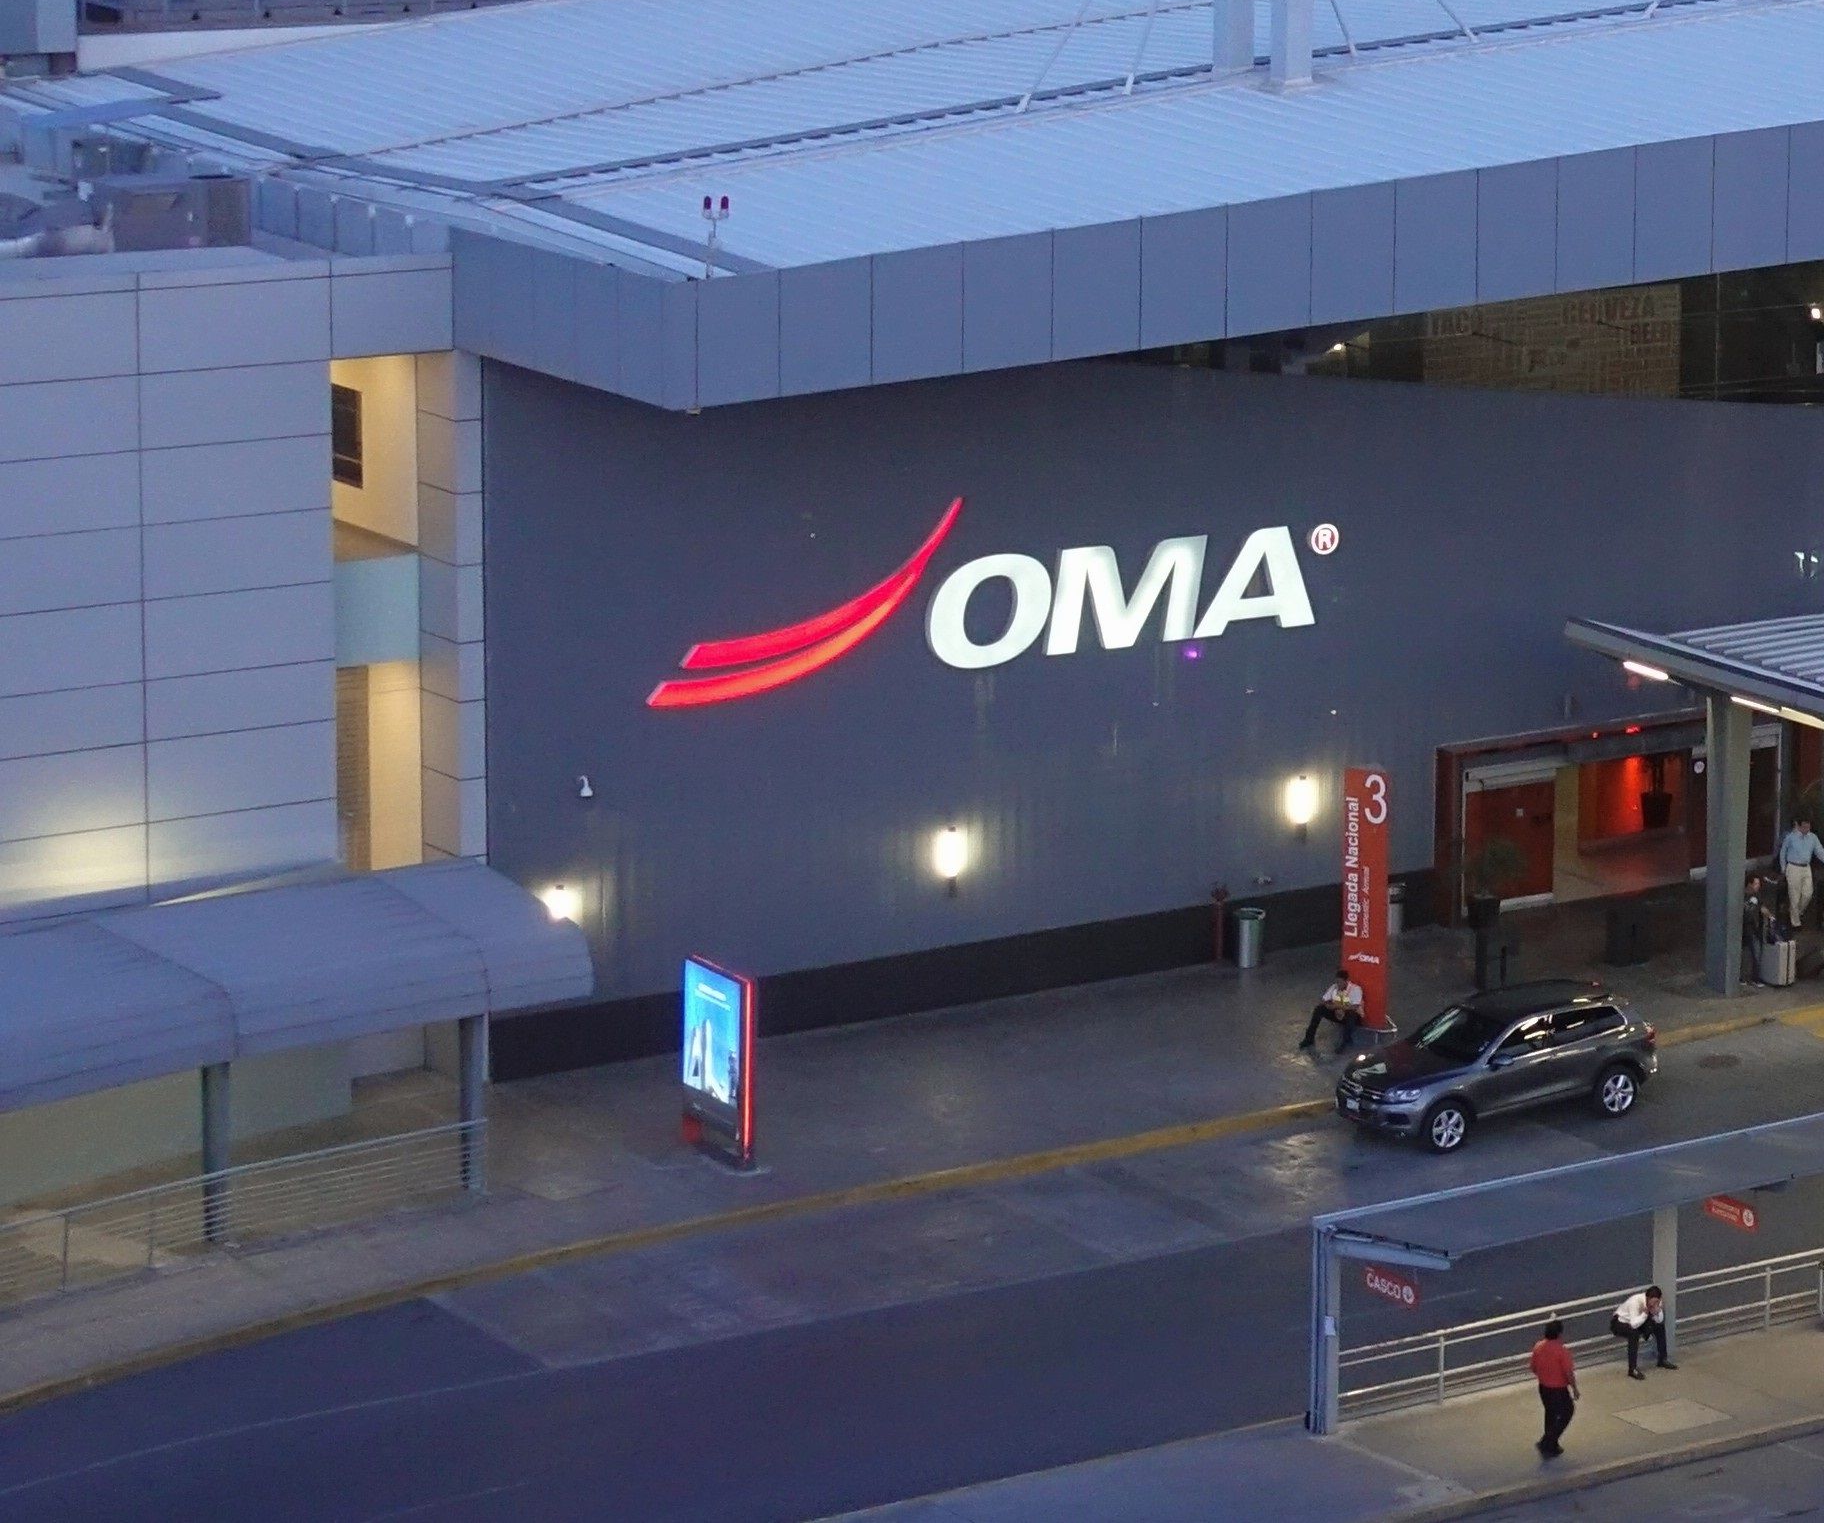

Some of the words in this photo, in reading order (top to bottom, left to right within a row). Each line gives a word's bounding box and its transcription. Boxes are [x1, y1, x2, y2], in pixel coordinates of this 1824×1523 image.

[1345, 796, 1360, 868] Nacional
[1364, 774, 1388, 825] 3
[1344, 872, 1361, 938] Llegada
